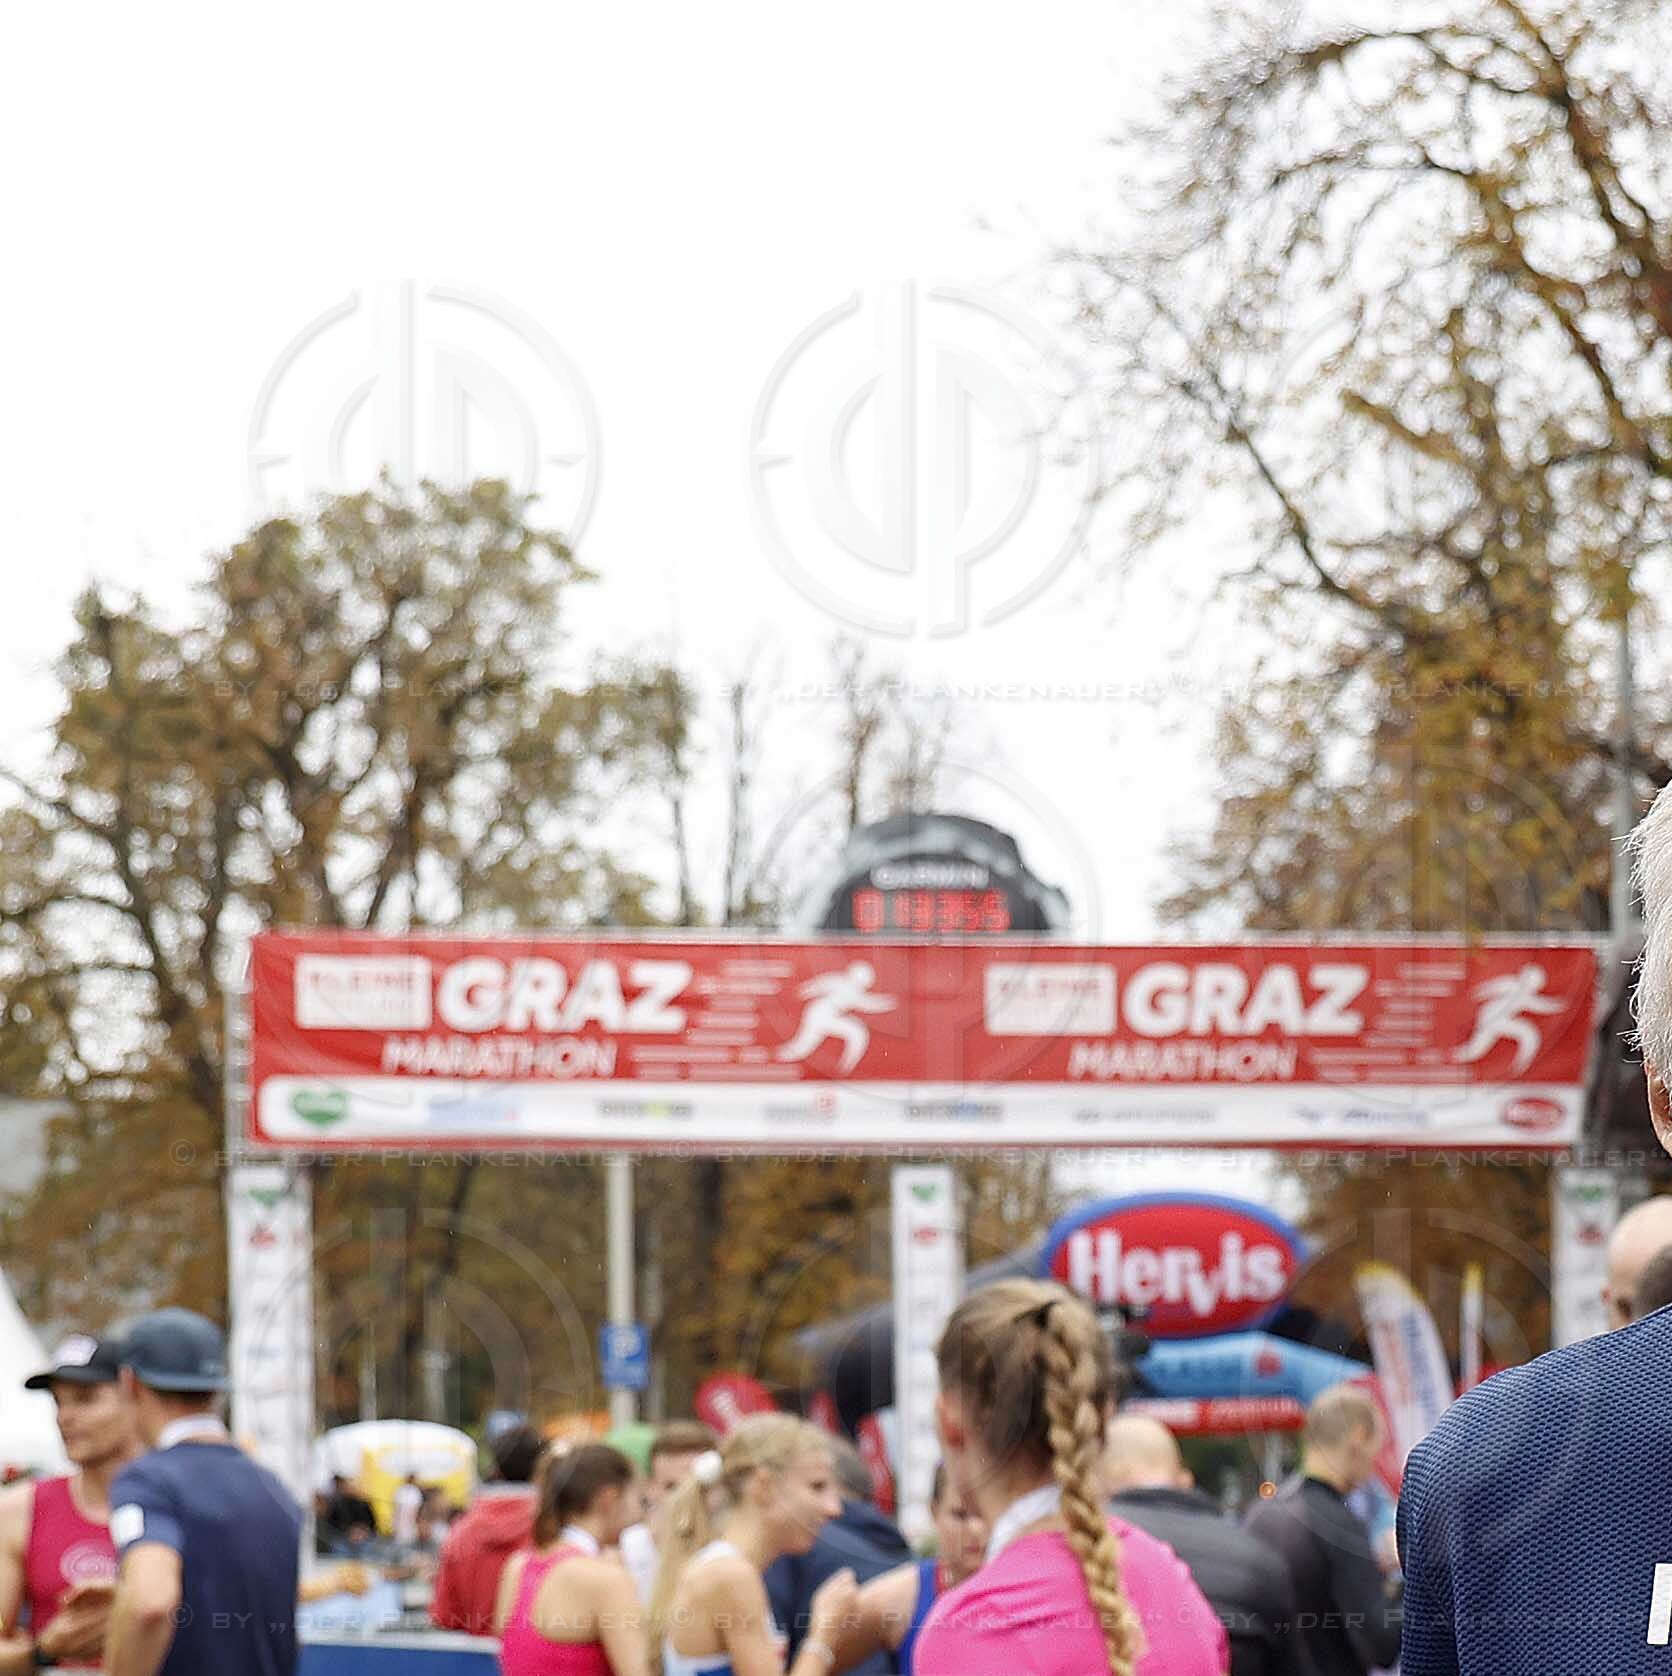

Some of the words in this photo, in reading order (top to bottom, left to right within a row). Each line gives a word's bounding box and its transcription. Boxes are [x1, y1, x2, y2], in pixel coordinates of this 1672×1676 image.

[438, 956, 693, 1034] GRAZ
[1122, 961, 1369, 1038] GRAZ
[380, 1034, 618, 1079] MARATHON
[1066, 1039, 1299, 1081] MARATHON
[1066, 1229, 1287, 1315] Hervis
